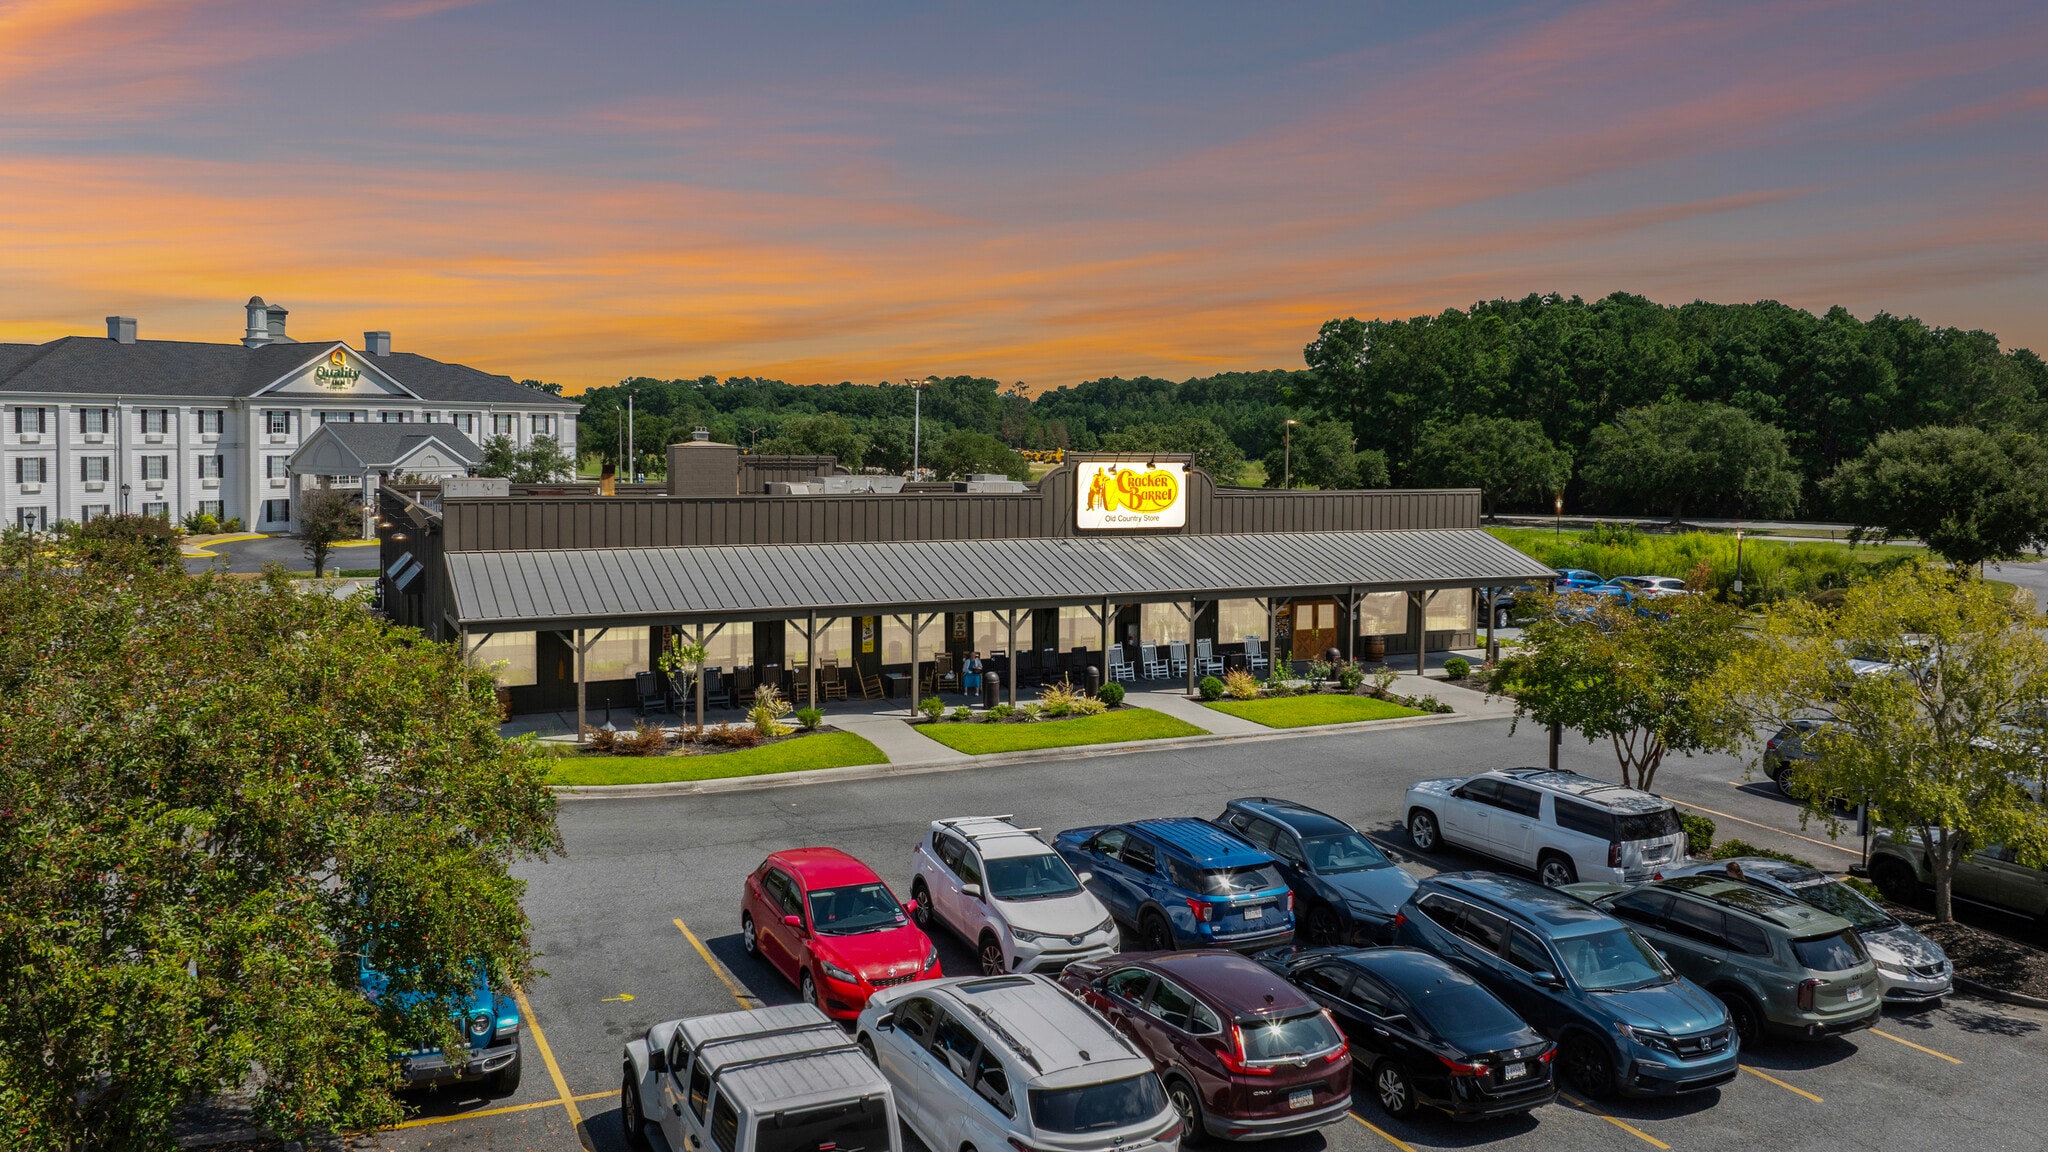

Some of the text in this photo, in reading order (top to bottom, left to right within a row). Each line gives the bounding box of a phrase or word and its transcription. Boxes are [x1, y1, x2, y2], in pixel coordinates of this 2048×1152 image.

[316, 366, 361, 381] Quality
[1117, 470, 1168, 493] Cracker
[1129, 487, 1172, 509] Barrel
